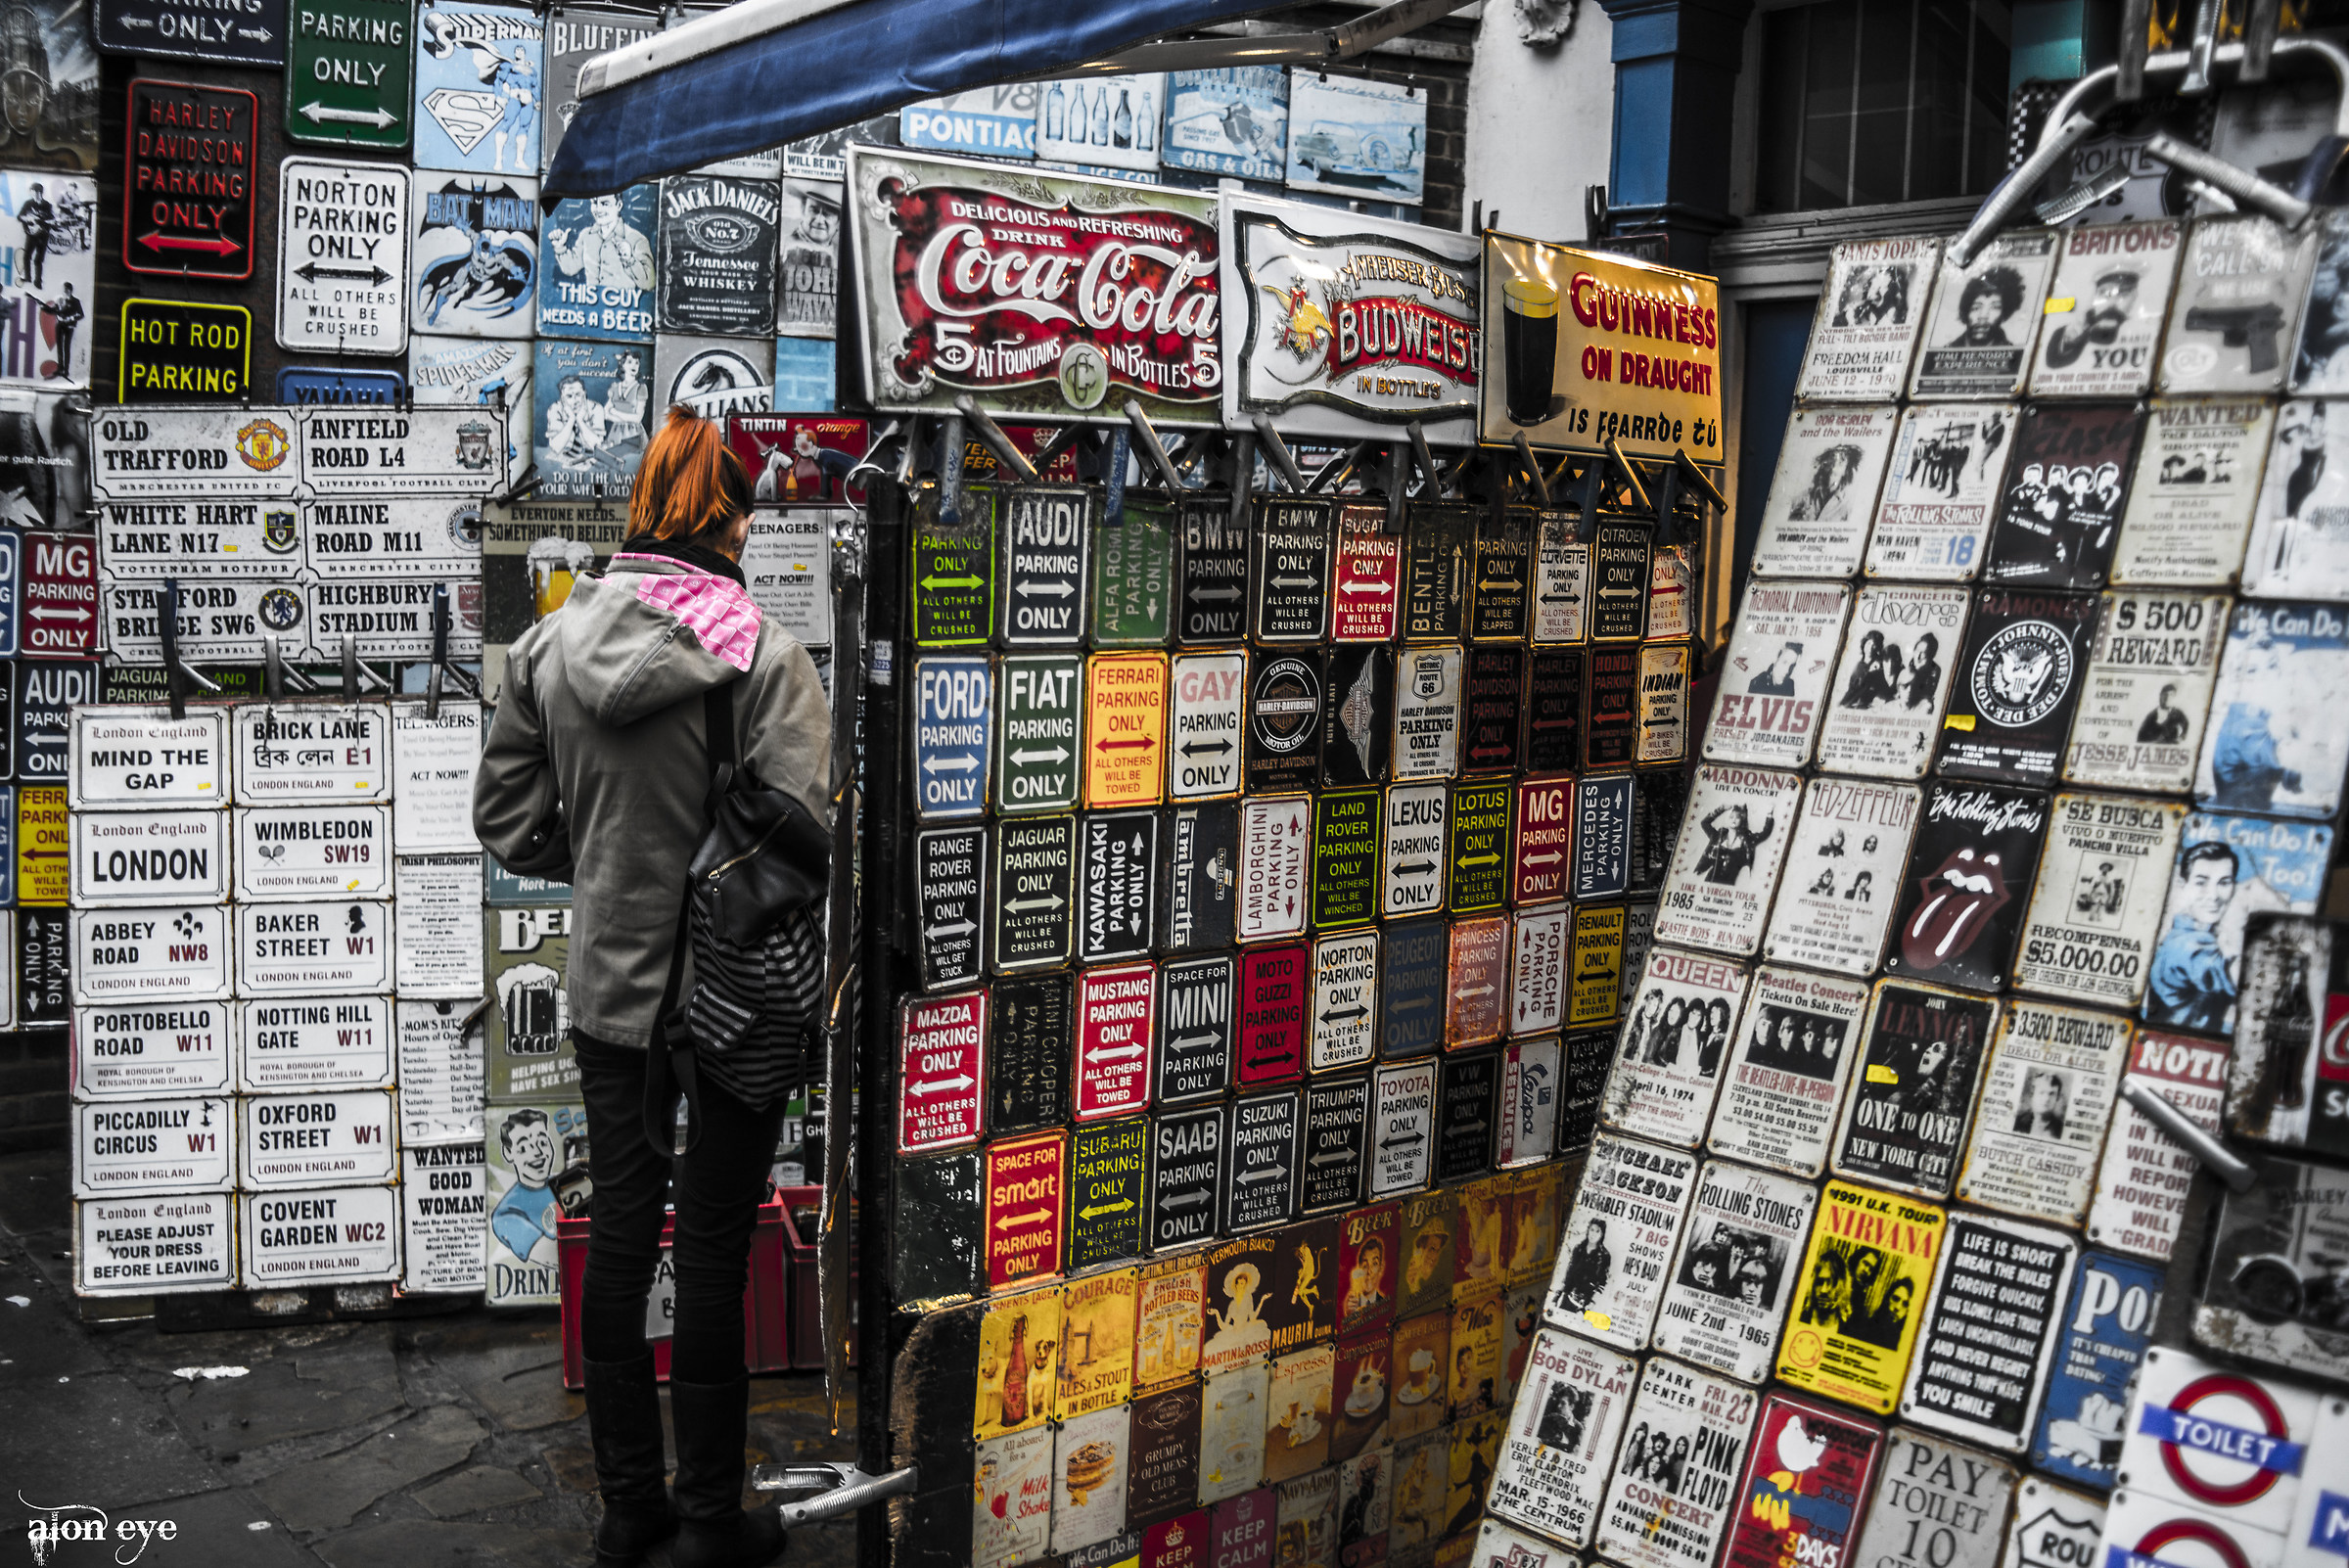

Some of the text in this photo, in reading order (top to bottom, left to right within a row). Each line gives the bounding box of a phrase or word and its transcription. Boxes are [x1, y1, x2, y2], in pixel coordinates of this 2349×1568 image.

[159, 17, 234, 43] ONLY
[301, 12, 403, 45] PARKING
[423, 12, 543, 60] SUPERMAN
[313, 57, 386, 86] ONLY
[151, 100, 235, 131] HARLEY
[139, 132, 243, 165] DAVIDSON
[138, 168, 243, 198] PARKING
[298, 179, 395, 207] NORTON
[666, 182, 779, 225] JACK DANIEL'S
[153, 203, 225, 229] ONLY
[294, 206, 397, 235] PARKING
[951, 202, 1182, 244] DELICIOUS AND REFRESHING
[992, 230, 1066, 249] DRINK
[2070, 225, 2177, 255] BRITONS
[684, 276, 758, 292] WHISKEY
[918, 223, 1220, 338] Coca-Cola
[291, 288, 395, 305] ALL OTHERS
[558, 282, 642, 309] THIS GUY
[543, 308, 652, 332] NEEDS A BEER
[1570, 271, 1717, 351] GUINNESS
[131, 320, 240, 348] HOT ROD
[305, 321, 379, 337] CRUSHED
[1338, 302, 1479, 372] BUDWEISE
[2092, 347, 2145, 369] YOU
[1582, 346, 1712, 396] ON DRAUGHT
[1357, 376, 1441, 400] IN BOTTLES
[103, 421, 149, 441] OLD
[310, 419, 410, 439] ANFIELD
[740, 419, 860, 439] TINTIN orange
[104, 449, 228, 470] TRAFFORD
[312, 447, 406, 467] ROAD L4
[111, 505, 257, 527] WHITE HART
[315, 504, 389, 525] MAINE
[512, 508, 572, 522] EVERYONE
[1017, 503, 1080, 546] AUDI
[35, 544, 90, 578] MG
[319, 612, 419, 632] STADIUM
[2107, 637, 2201, 667] REWARD
[1097, 669, 1160, 685] FERRARI
[1269, 663, 1305, 675] GENUINE
[24, 669, 91, 705] AUDI
[1011, 669, 1074, 711] FIAT
[1180, 671, 1238, 703] GAY
[1642, 673, 1681, 691] INDIAN
[920, 669, 986, 720] FORD
[1716, 694, 1814, 733] ELVIS
[91, 725, 207, 740] London England
[253, 721, 371, 740] BRICK LANE
[921, 725, 983, 747] PARKING
[91, 749, 209, 766] MIND THE
[254, 746, 290, 768] ব্রিক
[297, 749, 334, 767] লেন
[346, 747, 373, 765] E1
[1095, 757, 1152, 767] ALL OTHERS
[125, 773, 174, 790] GAP
[253, 779, 334, 789] LONDON ENGLAND
[1012, 775, 1066, 799] ONLY
[1106, 783, 1140, 794] TOWED
[1705, 767, 1798, 791] MADONNA
[1331, 802, 1365, 816] LAND
[1458, 792, 1505, 811] LOTUS
[1528, 790, 1563, 823] MG
[1392, 799, 1443, 827] LEXUS
[254, 820, 373, 841] WIMBLEDON
[1008, 827, 1065, 847] JAGUAR
[1581, 786, 1598, 890] MERCEDES
[324, 845, 370, 863] SW19
[930, 839, 973, 855] RANGE
[93, 849, 208, 881] LONDON
[930, 860, 972, 877] ROVER
[1248, 807, 1267, 930] LAMBORGHINI
[1089, 822, 1108, 951] KAWASAKI
[1323, 903, 1363, 914] WINCHED
[1665, 892, 1693, 910] 1985
[91, 922, 155, 942] ABBEY
[255, 914, 320, 933] BAKER
[1578, 913, 1623, 930] RENAULT
[255, 938, 331, 956] STREET
[346, 937, 374, 955] W1
[1011, 940, 1055, 952] CRUSHED
[2031, 924, 2142, 952] RECOMPENSA
[169, 944, 208, 962] NW8
[1320, 945, 1373, 967] NORTON
[1387, 934, 1441, 967] PEUGEOT
[941, 966, 963, 979] STUCK
[1543, 921, 1561, 1019] PORSCHE
[91, 976, 191, 990] LONDON ENGLAND
[1088, 980, 1149, 1000] MUSTANG
[1255, 984, 1291, 1002] GUZZI
[257, 1005, 372, 1027] NOTTING HILL
[917, 1004, 972, 1029] MAZDA
[1171, 982, 1224, 1030] MINI
[94, 1011, 210, 1033] PORTOBELLO
[177, 1035, 212, 1052] W11
[257, 1031, 299, 1049] GATE
[1096, 1090, 1130, 1104] TOWED
[1311, 1087, 1364, 1111] TRIUMPH
[94, 1110, 190, 1131] PICCADILLY
[258, 1103, 337, 1126] OXFORD
[1242, 1103, 1288, 1125] SUZUKI
[1858, 1098, 1960, 1145] ONE TO ONE
[94, 1135, 158, 1155] CIRCUS
[258, 1129, 331, 1150] STREET
[1159, 1120, 1218, 1159] SAAB
[996, 1148, 1056, 1173] SPACE FOR
[1849, 1138, 1951, 1176] NEW YORK CITY
[430, 1171, 472, 1191] GOOD
[993, 1174, 1056, 1207] smart
[260, 1200, 337, 1222] COVENT
[418, 1196, 484, 1216] WOMAN
[1700, 1183, 1803, 1230] ROLLING STONES
[97, 1224, 214, 1242] PLEASE ADJUST
[260, 1222, 386, 1247] GARDEN WC2
[1823, 1205, 1932, 1259] NIRVANA
[109, 1242, 203, 1260] YOUR DRESS
[94, 1259, 219, 1279] BEFORE LEAVING
[1063, 1278, 1133, 1312] COURAGE
[1532, 1351, 1627, 1396] BOB DYLAN
[1920, 1384, 1996, 1419] YOU SMILE
[2174, 1416, 2276, 1462] TOILET
[1694, 1426, 1741, 1476] PINK
[1906, 1442, 1986, 1498] PAY
[1681, 1467, 1727, 1512] FLOYD
[1888, 1479, 1990, 1536] TOILET
